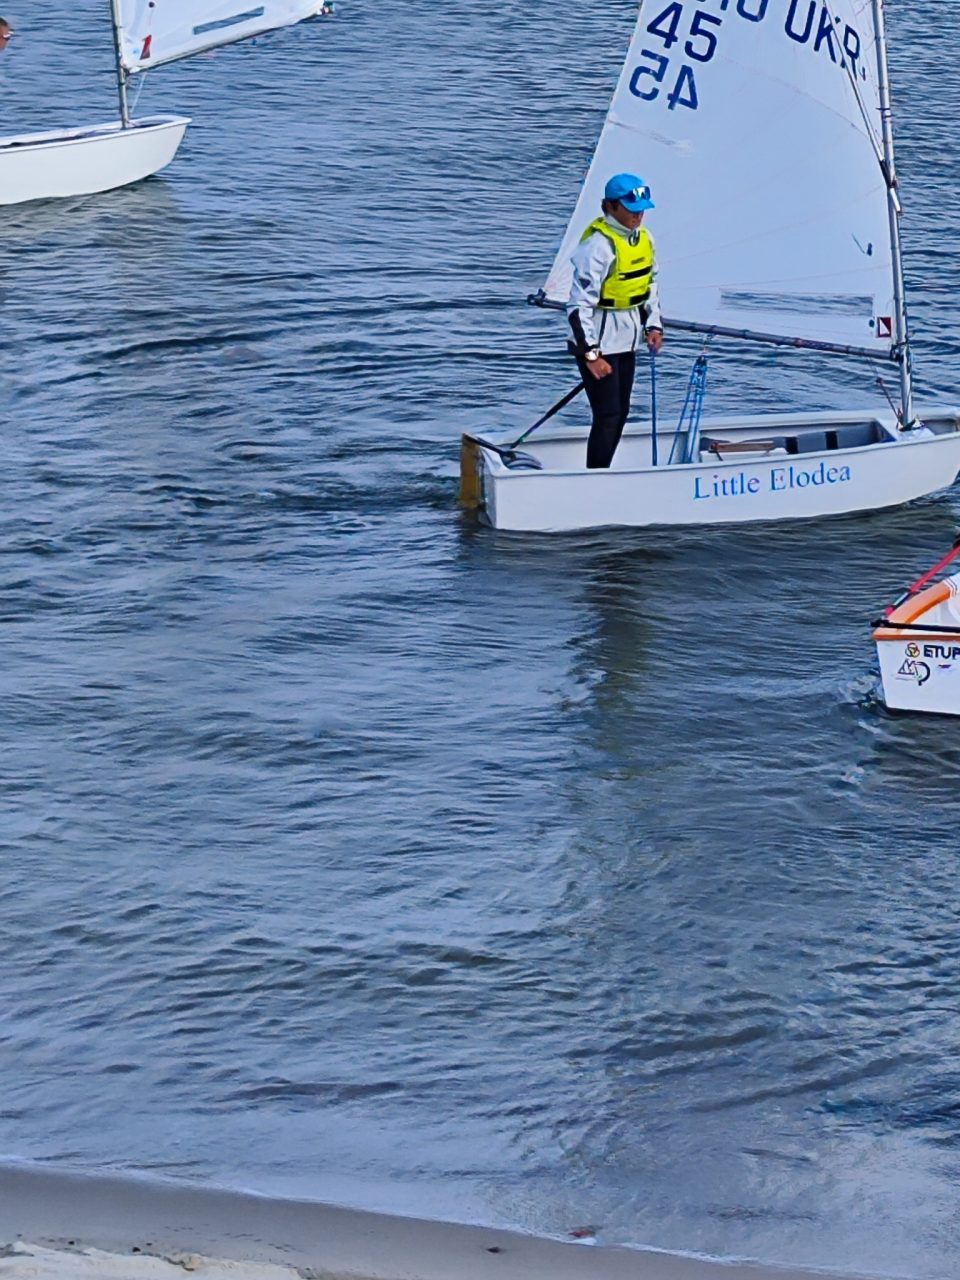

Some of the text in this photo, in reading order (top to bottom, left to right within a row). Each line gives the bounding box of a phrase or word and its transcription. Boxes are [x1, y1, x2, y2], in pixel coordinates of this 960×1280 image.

[647, 1, 722, 62] 45
[693, 462, 851, 500] Little Elodea
